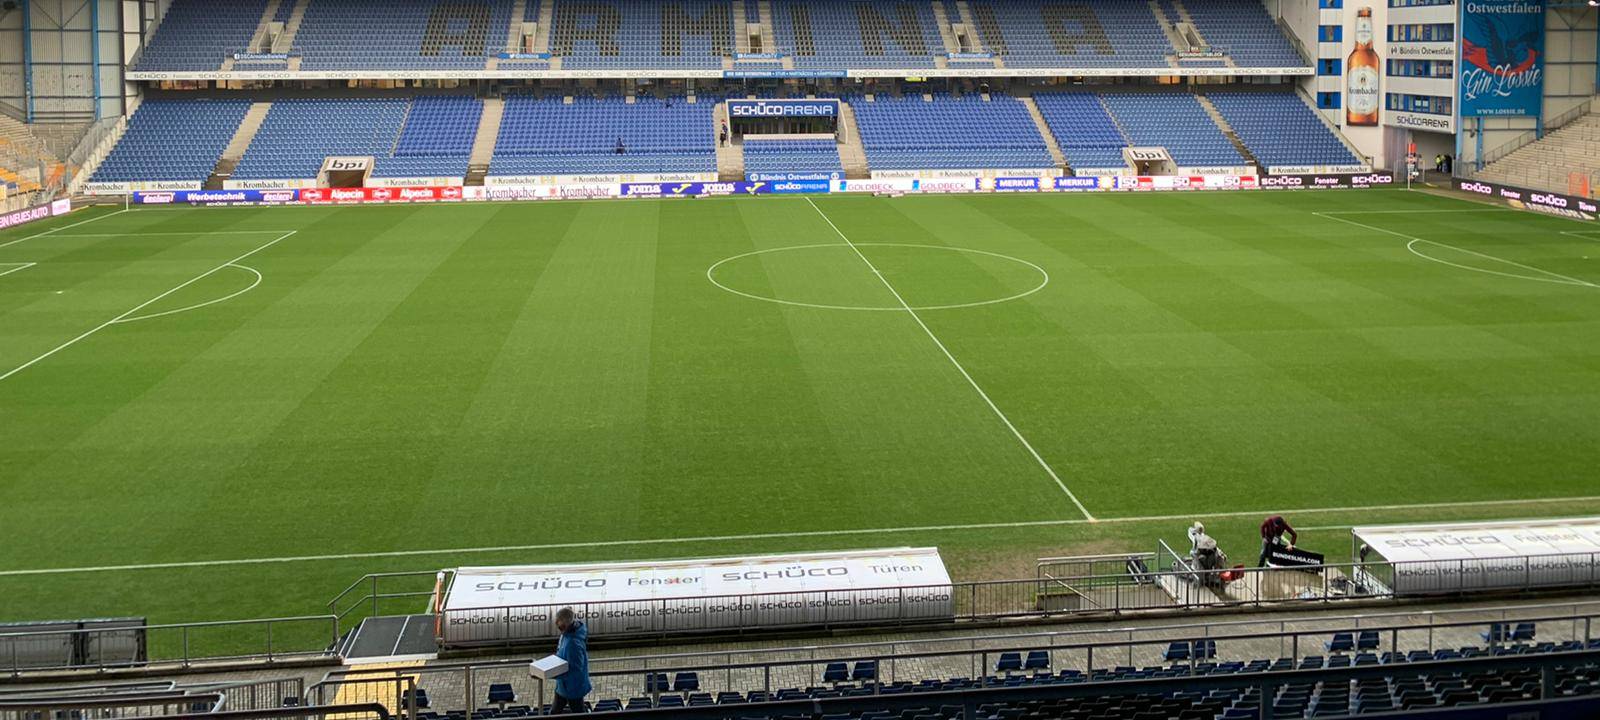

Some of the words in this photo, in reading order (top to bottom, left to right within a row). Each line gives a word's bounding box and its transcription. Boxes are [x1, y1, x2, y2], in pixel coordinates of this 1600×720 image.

[1467, 2, 1541, 13] Ostwestfalen
[1462, 68, 1494, 101] Gin
[1492, 63, 1541, 97] Lossie
[732, 102, 833, 115] SCHÜCOARENA
[1396, 115, 1449, 128] SCHÜCOARENA
[1132, 150, 1163, 160] bpi
[332, 159, 363, 169] bpi
[788, 172, 830, 180] Ostwestfalen
[1261, 176, 1302, 185] SCHÜCO
[1352, 174, 1392, 184] SCHÜCO
[84, 182, 124, 191] Krombacher
[157, 182, 197, 190] Krombacher
[243, 180, 285, 188] Krombacher
[1000, 179, 1035, 187] MERKUR
[1060, 178, 1094, 186] MERKUR
[187, 192, 246, 201] Werbetechnik
[330, 188, 364, 199] Alpecin
[400, 188, 434, 198] Alpecin
[485, 187, 536, 198] Krombacher
[560, 186, 609, 198] Krombacher
[1461, 182, 1492, 194] SCHÜCO
[1500, 188, 1521, 199] Fenster
[1531, 194, 1567, 208] SCHÜCO
[30, 206, 48, 220] AUTO
[1385, 535, 1501, 548] SCHÜCO
[1272, 552, 1320, 564] BUNDESLIGA.COM
[475, 576, 606, 592] SCHÜCO
[627, 574, 701, 587] Fenster
[722, 565, 849, 582] SCHÜCO
[869, 564, 923, 574] Türen
[450, 614, 495, 626] SCHÜCO
[502, 612, 547, 623] SCHÜCO
[606, 608, 651, 618] SCHÜCO
[658, 605, 702, 616] SCHÜCO
[709, 602, 752, 613] SCHÜCO
[759, 600, 802, 610] SCHÜCO
[809, 598, 852, 608] SCHÜCO
[858, 595, 901, 606] SCHÜCO
[907, 592, 950, 602] SCHÜCO
